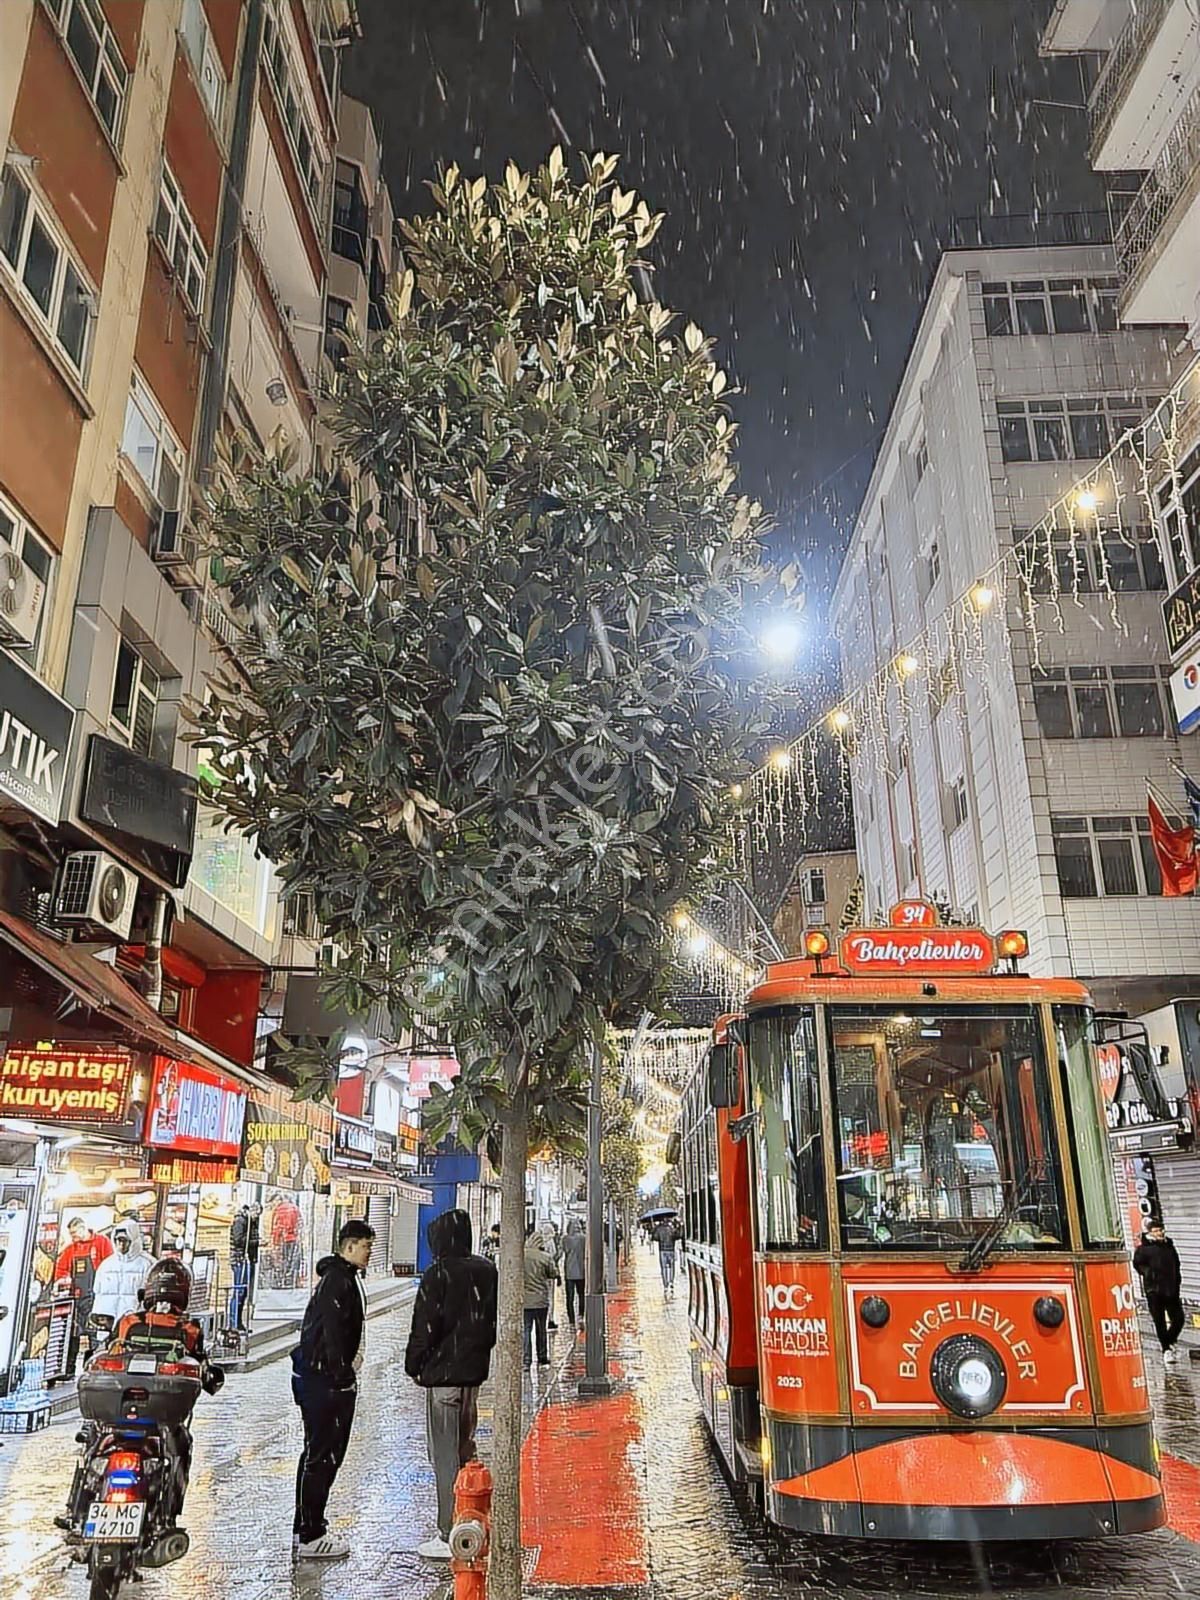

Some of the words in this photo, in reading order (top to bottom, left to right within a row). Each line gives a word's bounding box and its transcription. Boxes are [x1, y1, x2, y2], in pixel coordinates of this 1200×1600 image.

[902, 905, 926, 924] 34
[851, 937, 984, 965] Bahçelievler
[2, 1053, 125, 1084] nişantaşı
[2, 1083, 119, 1113] kuruyemiş
[774, 1317, 827, 1333] HAKAN
[1101, 1318, 1125, 1334] DR.
[777, 1375, 803, 1388] 2023
[90, 1505, 108, 1519] 34
[115, 1504, 140, 1519] MC
[98, 1521, 135, 1536] 4710
